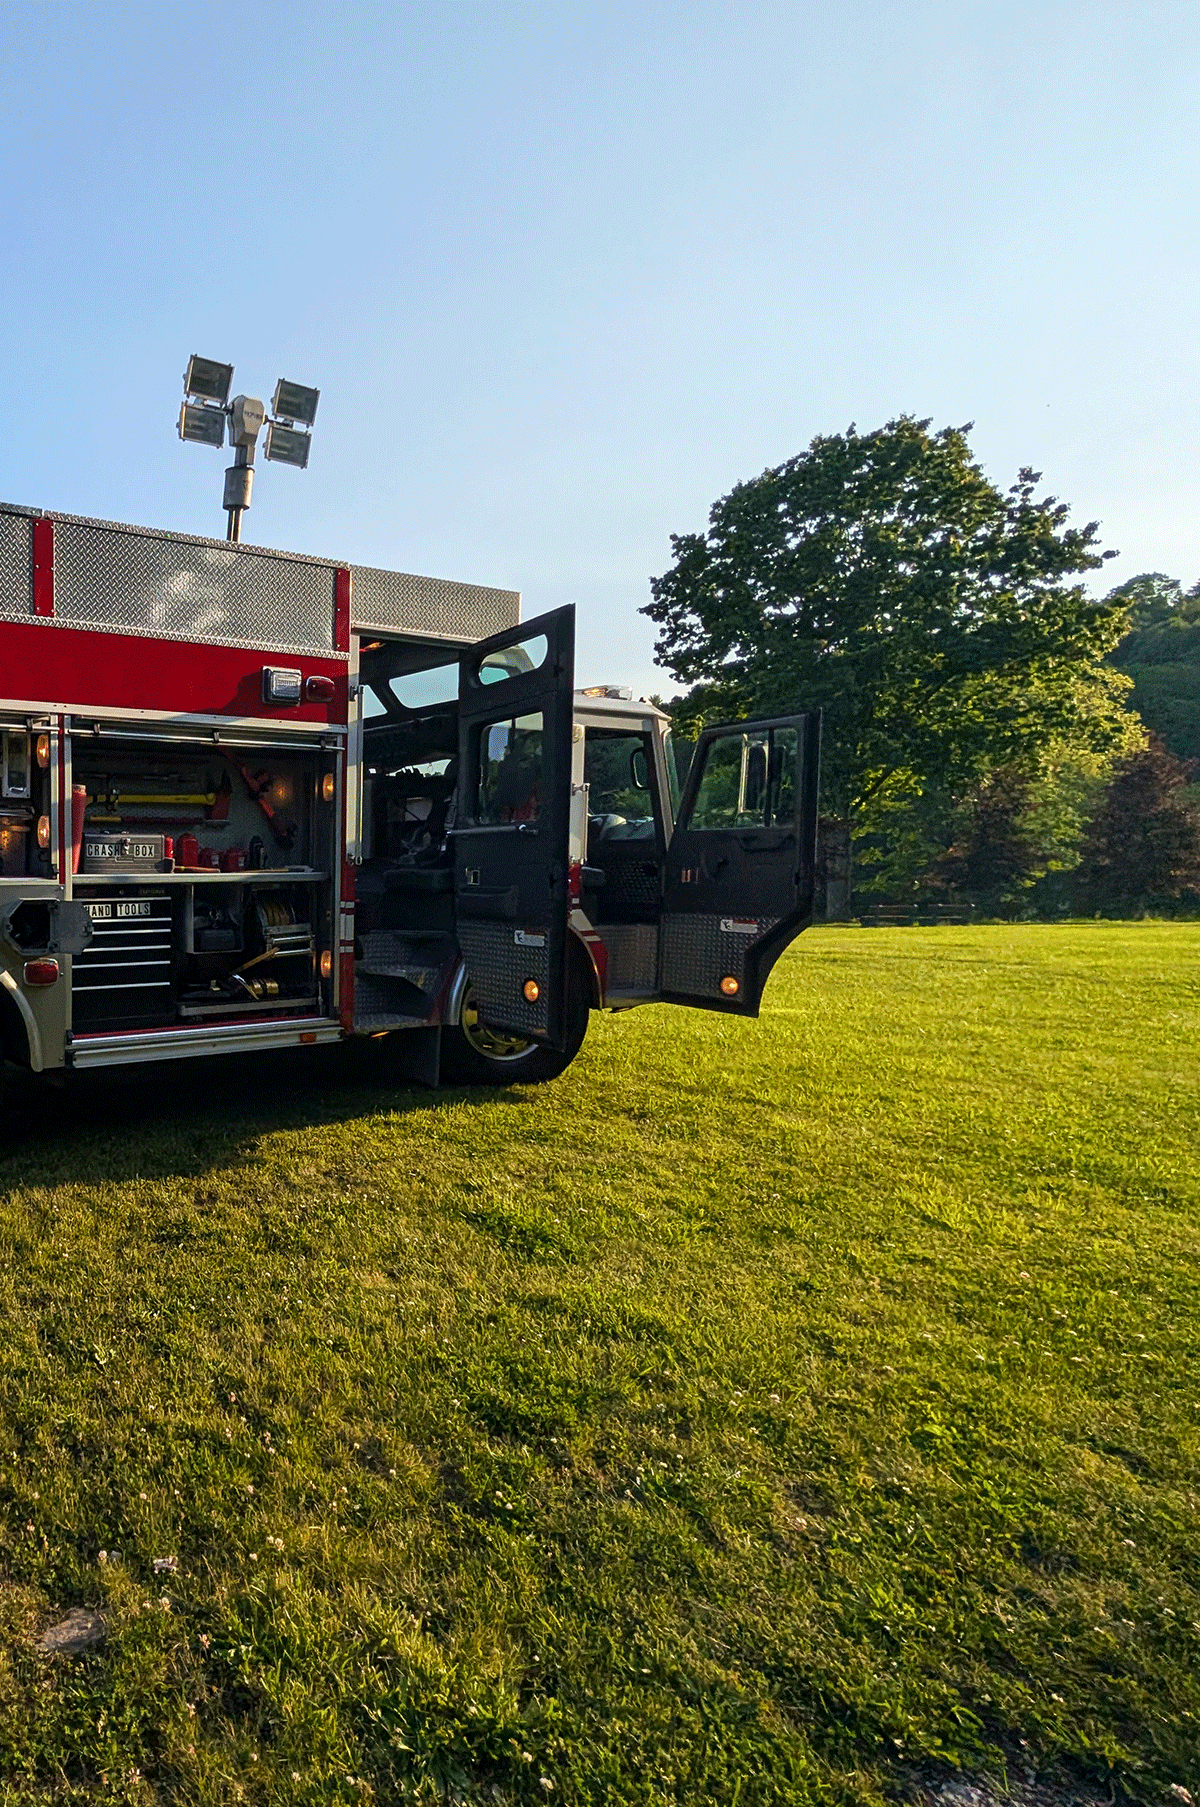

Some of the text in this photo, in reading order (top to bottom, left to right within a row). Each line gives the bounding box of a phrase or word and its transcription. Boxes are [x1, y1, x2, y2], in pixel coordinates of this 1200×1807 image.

[87, 844, 154, 857] CRASH BOX
[117, 903, 150, 916] TOOLS
